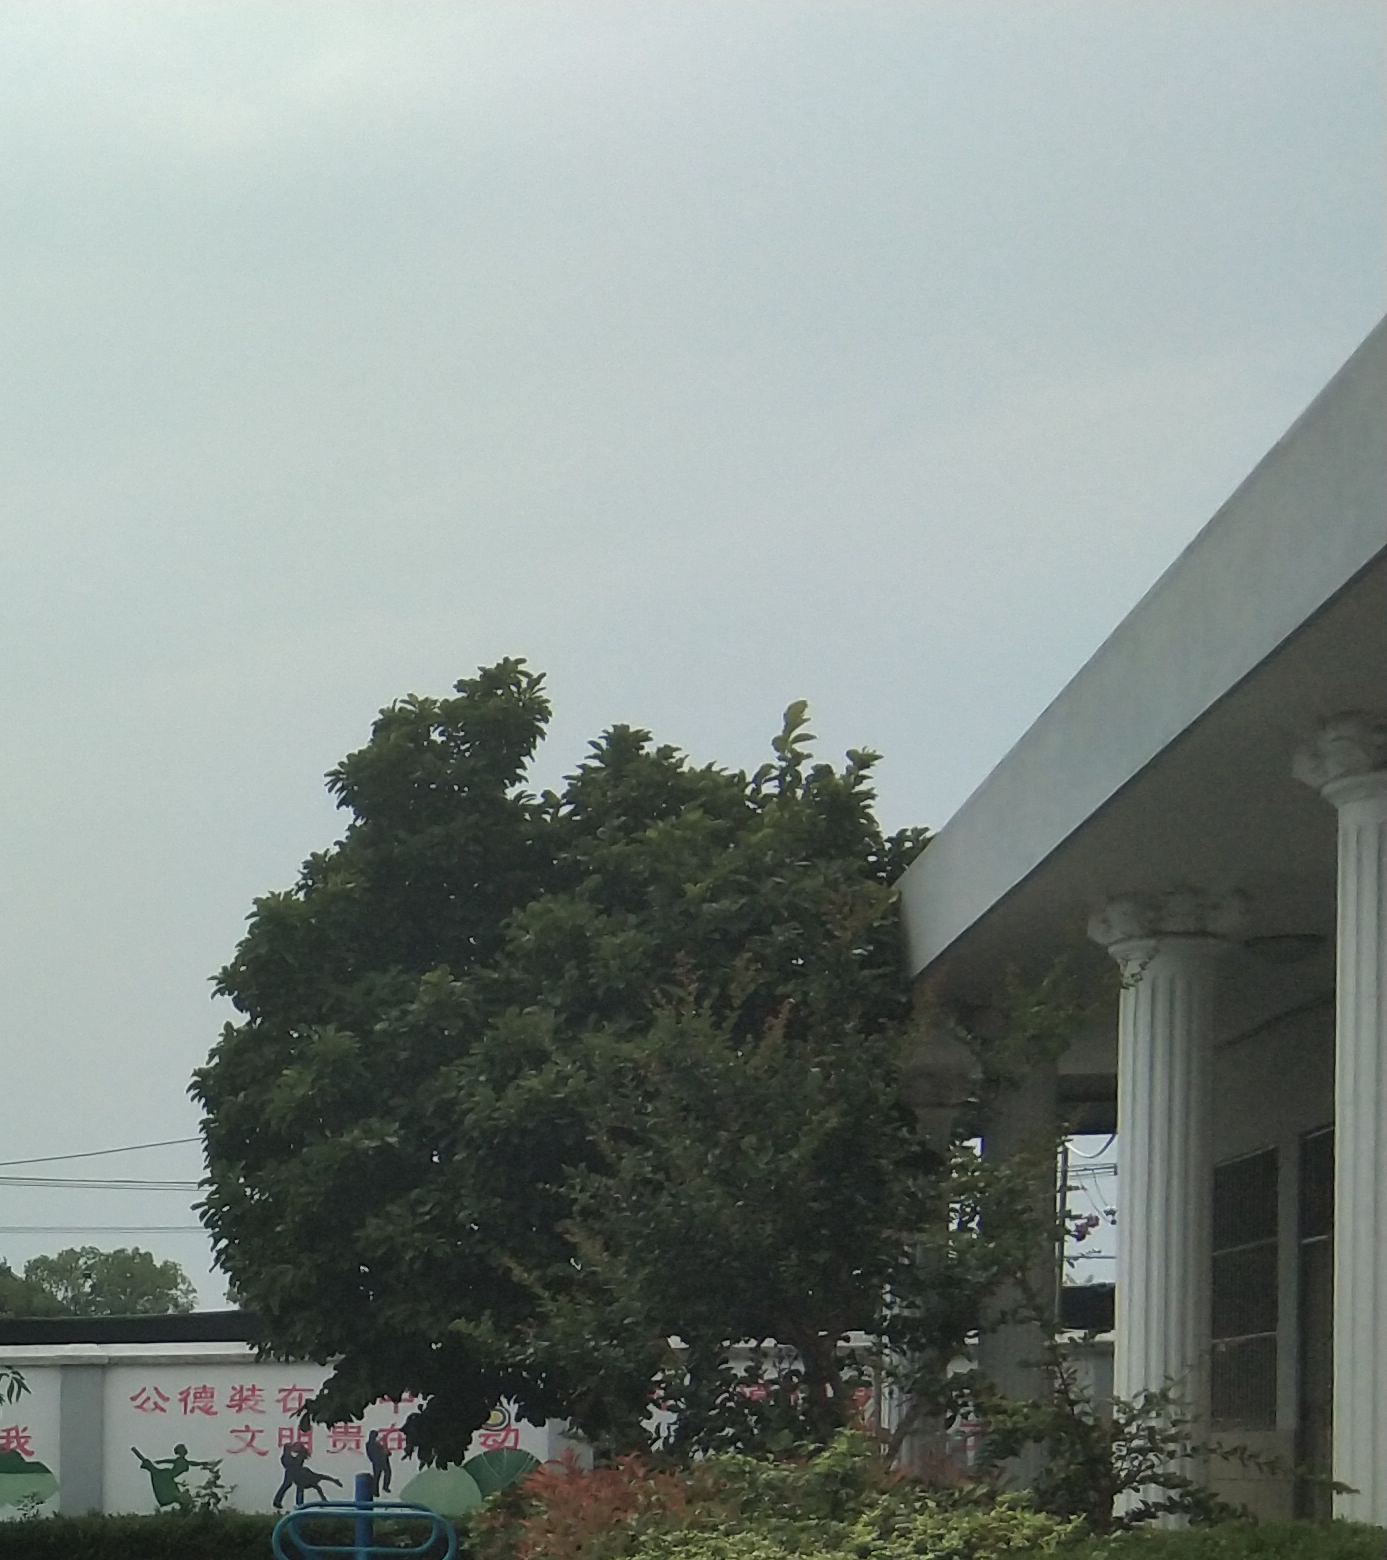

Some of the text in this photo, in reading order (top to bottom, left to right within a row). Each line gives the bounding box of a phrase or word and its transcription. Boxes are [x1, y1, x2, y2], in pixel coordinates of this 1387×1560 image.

[228, 1424, 519, 1457] 文明贵在动
